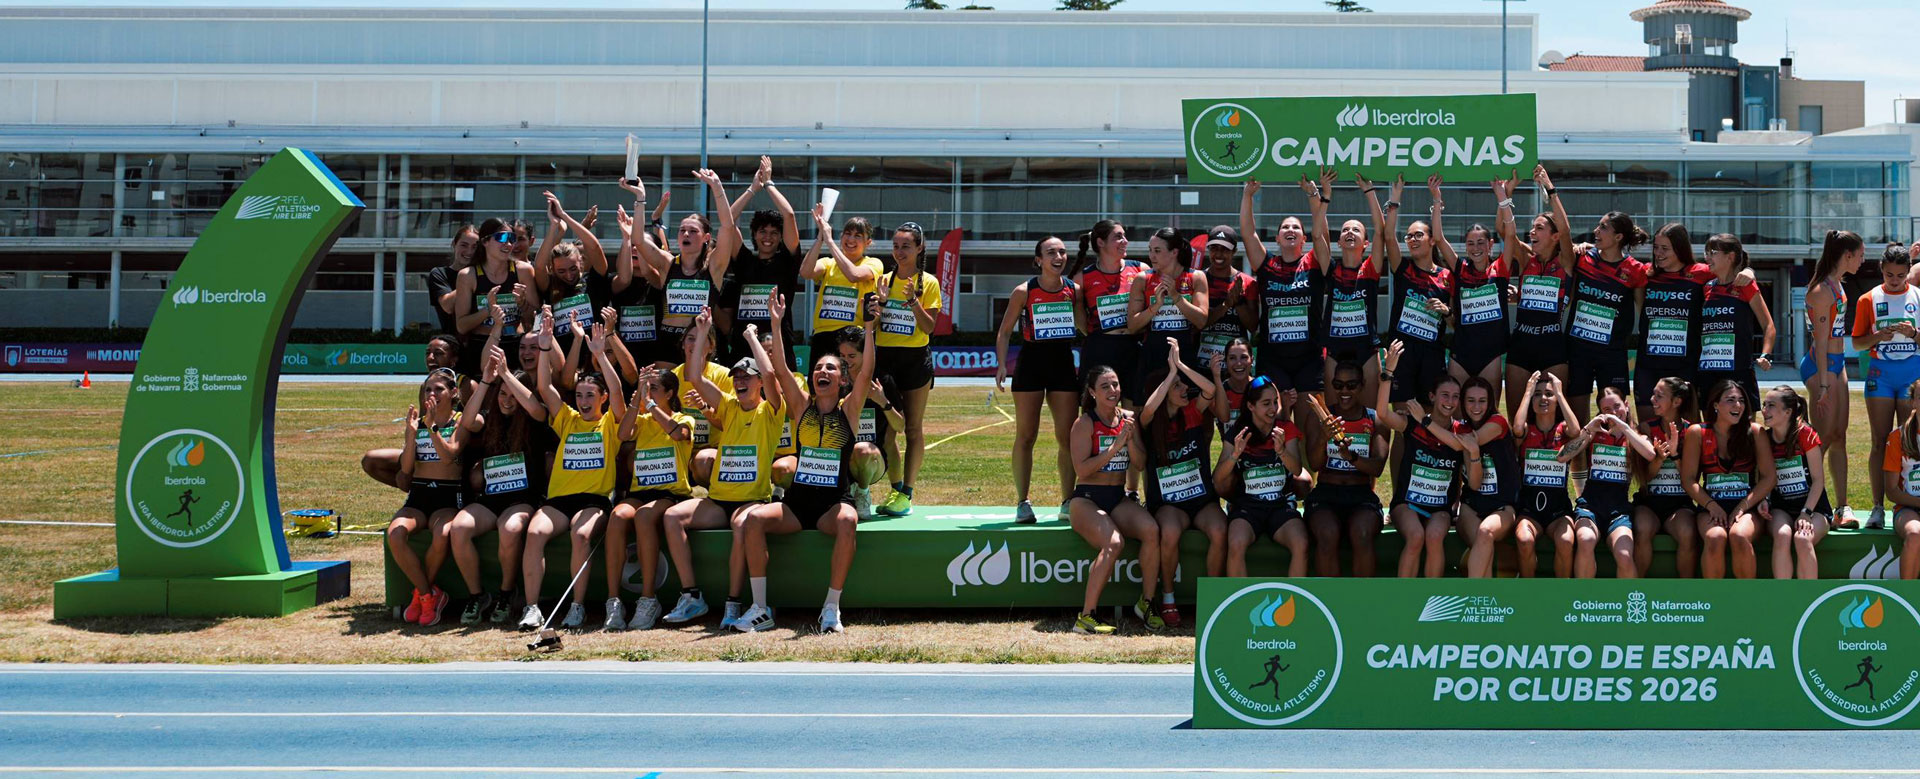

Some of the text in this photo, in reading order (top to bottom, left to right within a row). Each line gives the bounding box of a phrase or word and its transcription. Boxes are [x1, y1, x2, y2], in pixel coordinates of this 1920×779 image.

[1373, 108, 1456, 126] Iberdrola
[1271, 134, 1526, 167] CAMPEONAS
[1238, 148, 1260, 170] ATLETISMO
[280, 196, 306, 204] RFEA
[202, 289, 266, 302] Iberdrola
[1578, 281, 1624, 302] Sanysec
[1274, 296, 1312, 305] PERSAN
[1528, 299, 1554, 310] Joma
[826, 311, 852, 320] Joma
[1588, 306, 1611, 316] Iberdrola
[1653, 307, 1689, 316] PERSAN
[1036, 317, 1062, 325] PAMPLONA
[1472, 311, 1499, 322] Joma
[1576, 315, 1611, 330] PAMPLONA 2026
[1705, 322, 1734, 330] PERSAN
[887, 324, 912, 334] Joma
[1047, 328, 1074, 338] Joma
[1339, 326, 1366, 336] Joma
[1406, 325, 1434, 339] Joma
[1518, 323, 1561, 335] NIKE PRO
[626, 331, 653, 341] Joma
[1278, 332, 1306, 342] Joma
[1580, 328, 1607, 342] Joma
[24, 348, 68, 356] LOTERÍAS
[1655, 346, 1683, 355] Joma
[1886, 344, 1916, 352] Joma
[350, 352, 408, 364] Iberdrola
[1705, 360, 1731, 368] Joma
[143, 374, 180, 382] Gobierno
[202, 374, 248, 382] Nafarroako
[646, 451, 671, 459] Iberdrola
[1416, 450, 1456, 468] Sanysec
[571, 459, 602, 468] Joma
[636, 464, 662, 472] PAMPLONA
[800, 462, 825, 471] PAMPLONA
[645, 474, 674, 485] Joma
[726, 472, 754, 481] Joma
[806, 474, 835, 484] Joma
[1534, 476, 1562, 485] Joma
[1600, 471, 1627, 480] Joma
[164, 476, 206, 486] Iberdrola
[496, 479, 524, 490] Joma
[1162, 476, 1190, 489] PAMPLONA
[1247, 481, 1273, 491] PAMPLONA
[1412, 480, 1437, 492] PAMPLONA
[1174, 486, 1202, 501] Joma
[1417, 494, 1444, 504] Joma
[138, 500, 231, 538] LIGA IBERDROLA ATLETISMO
[1468, 596, 1498, 604] RFEA
[1573, 600, 1622, 610] Gobierno
[1652, 600, 1711, 610] Nafarroako
[1464, 606, 1514, 615] ATLETISMO
[1564, 613, 1622, 622] de Navarra
[1652, 613, 1704, 622] Gobernua
[1247, 638, 1296, 650] Iberdrola
[1838, 640, 1887, 651] Iberdrola
[1366, 638, 1776, 669] CAMPEONATO DE ESPAÑA
[1214, 668, 1326, 713] LIGA IBERDROLA ATLETISMO
[1434, 677, 1718, 702] POR CLUBES 2026
[1808, 668, 1919, 714] LIGA IBERDROLA ATLETISMO
